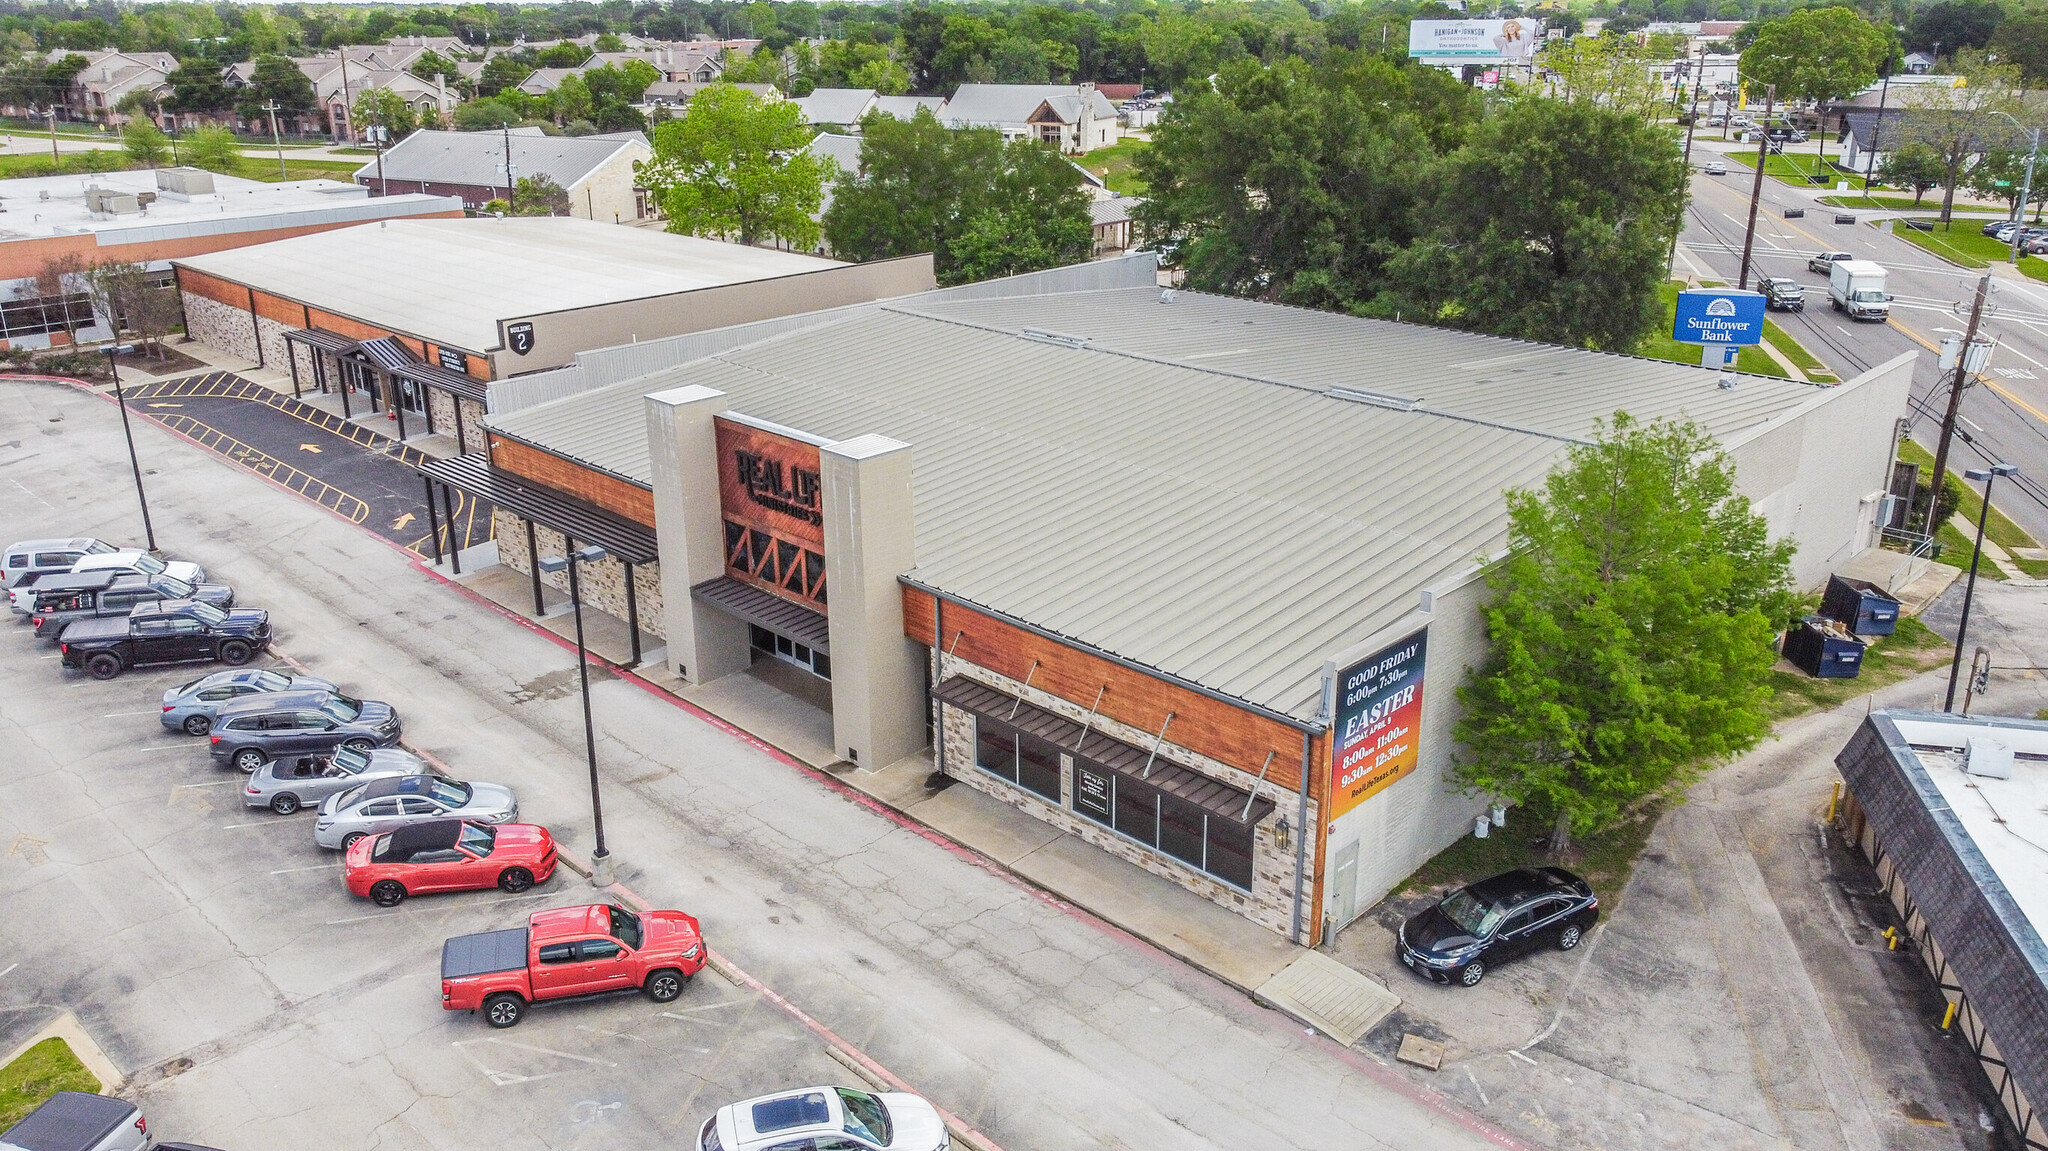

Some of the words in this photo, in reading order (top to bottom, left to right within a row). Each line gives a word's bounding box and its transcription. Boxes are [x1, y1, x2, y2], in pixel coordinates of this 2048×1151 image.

[510, 324, 532, 333] BUILDING
[1687, 317, 1750, 331] Sunflower
[1701, 329, 1733, 341] Bank
[517, 333, 526, 350] 2
[1993, 367, 2040, 380] ONLY
[735, 450, 792, 501] REAL
[790, 465, 821, 509] LIF
[1347, 665, 1378, 690] GOOD
[1378, 643, 1419, 674] FRIDAY
[1346, 685, 1378, 707] 6:00pm
[1379, 669, 1408, 690] 7:30pm
[1344, 684, 1415, 740] EASTER
[1368, 722, 1387, 736] APRIL
[1387, 716, 1392, 725] 9
[1342, 746, 1375, 770] 8:00am
[1376, 726, 1409, 750] 11:00am
[1341, 765, 1373, 789] 9:30am
[1375, 744, 1409, 768] 12:30pm
[1351, 764, 1400, 799] RealLifeTexas.org
[1471, 1120, 1491, 1134] FIRE
[1493, 1132, 1516, 1148] LANE
